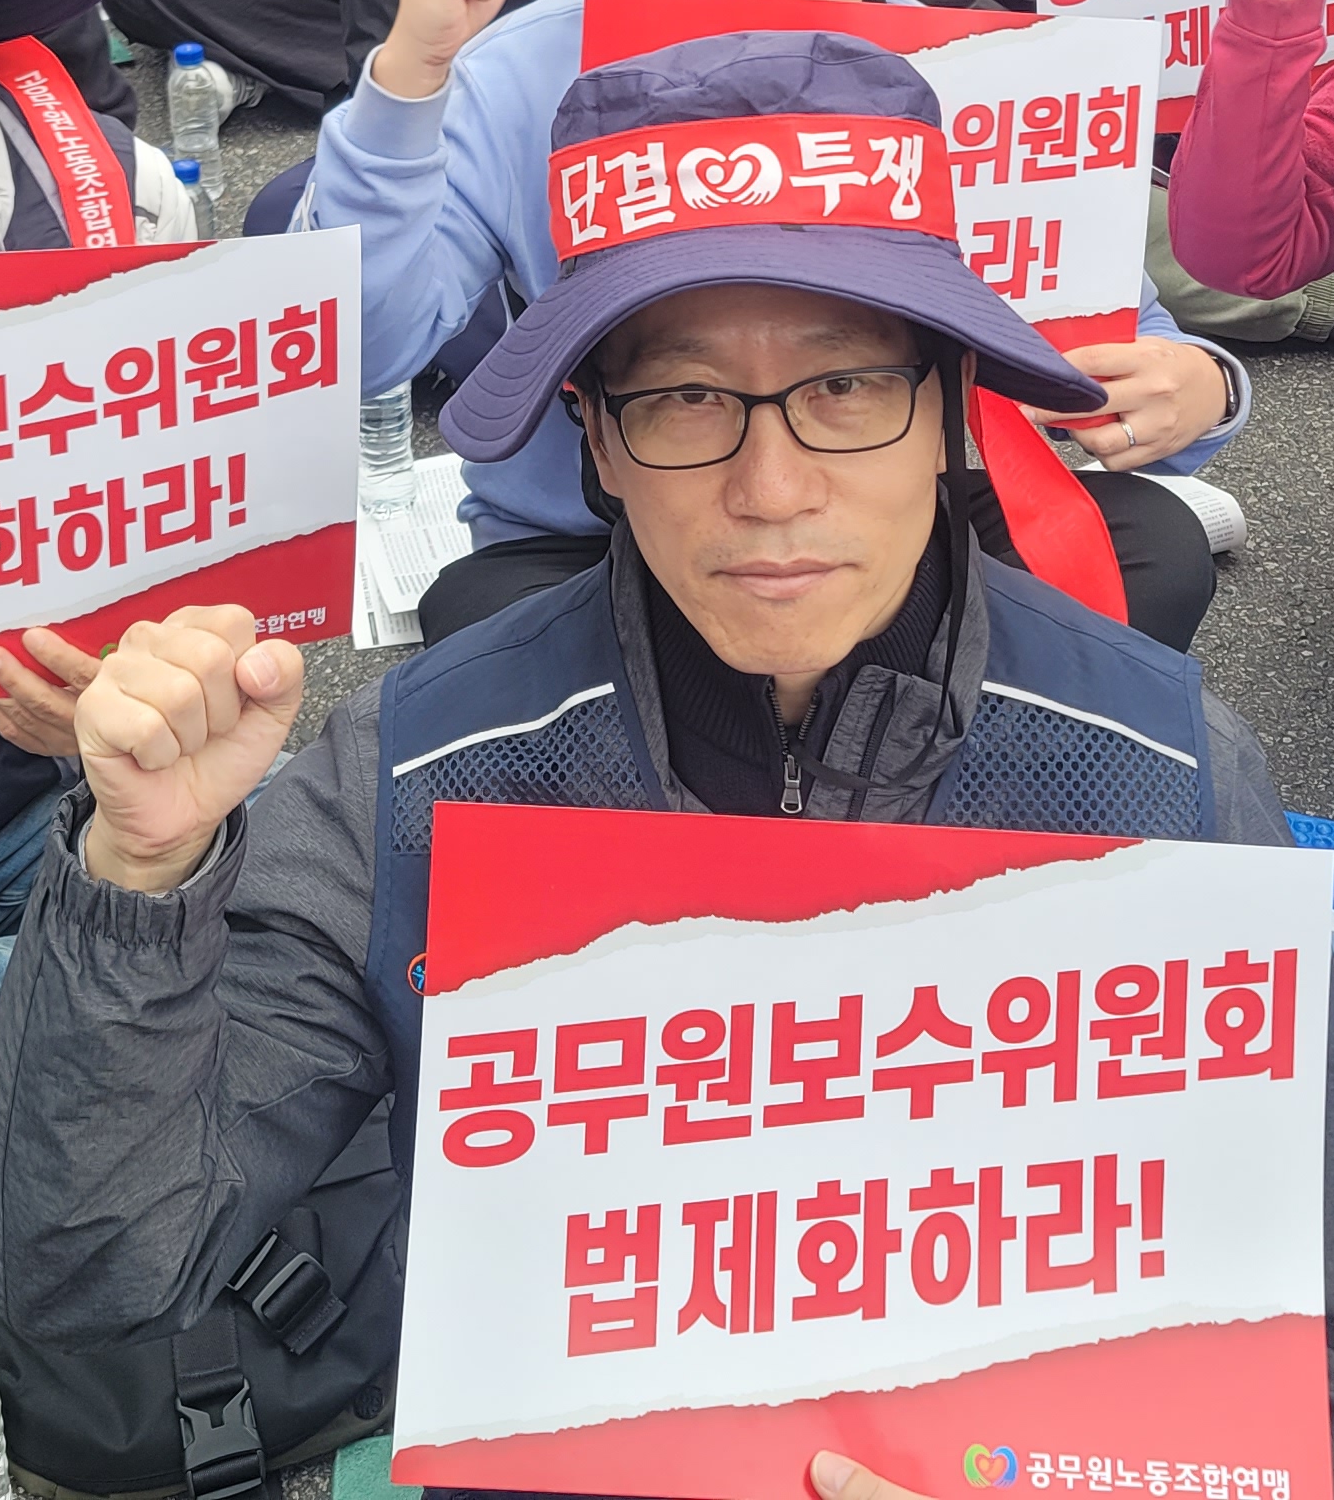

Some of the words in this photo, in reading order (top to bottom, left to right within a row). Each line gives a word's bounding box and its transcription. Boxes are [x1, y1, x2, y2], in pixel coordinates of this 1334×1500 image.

[559, 141, 678, 247] 단결
[788, 129, 924, 220] 투쟁
[439, 946, 1299, 1168] 공무원보수위원회
[563, 1152, 1167, 1358] 법제화하라!
[1025, 1448, 1291, 1500] 공무원노동조합연맹
